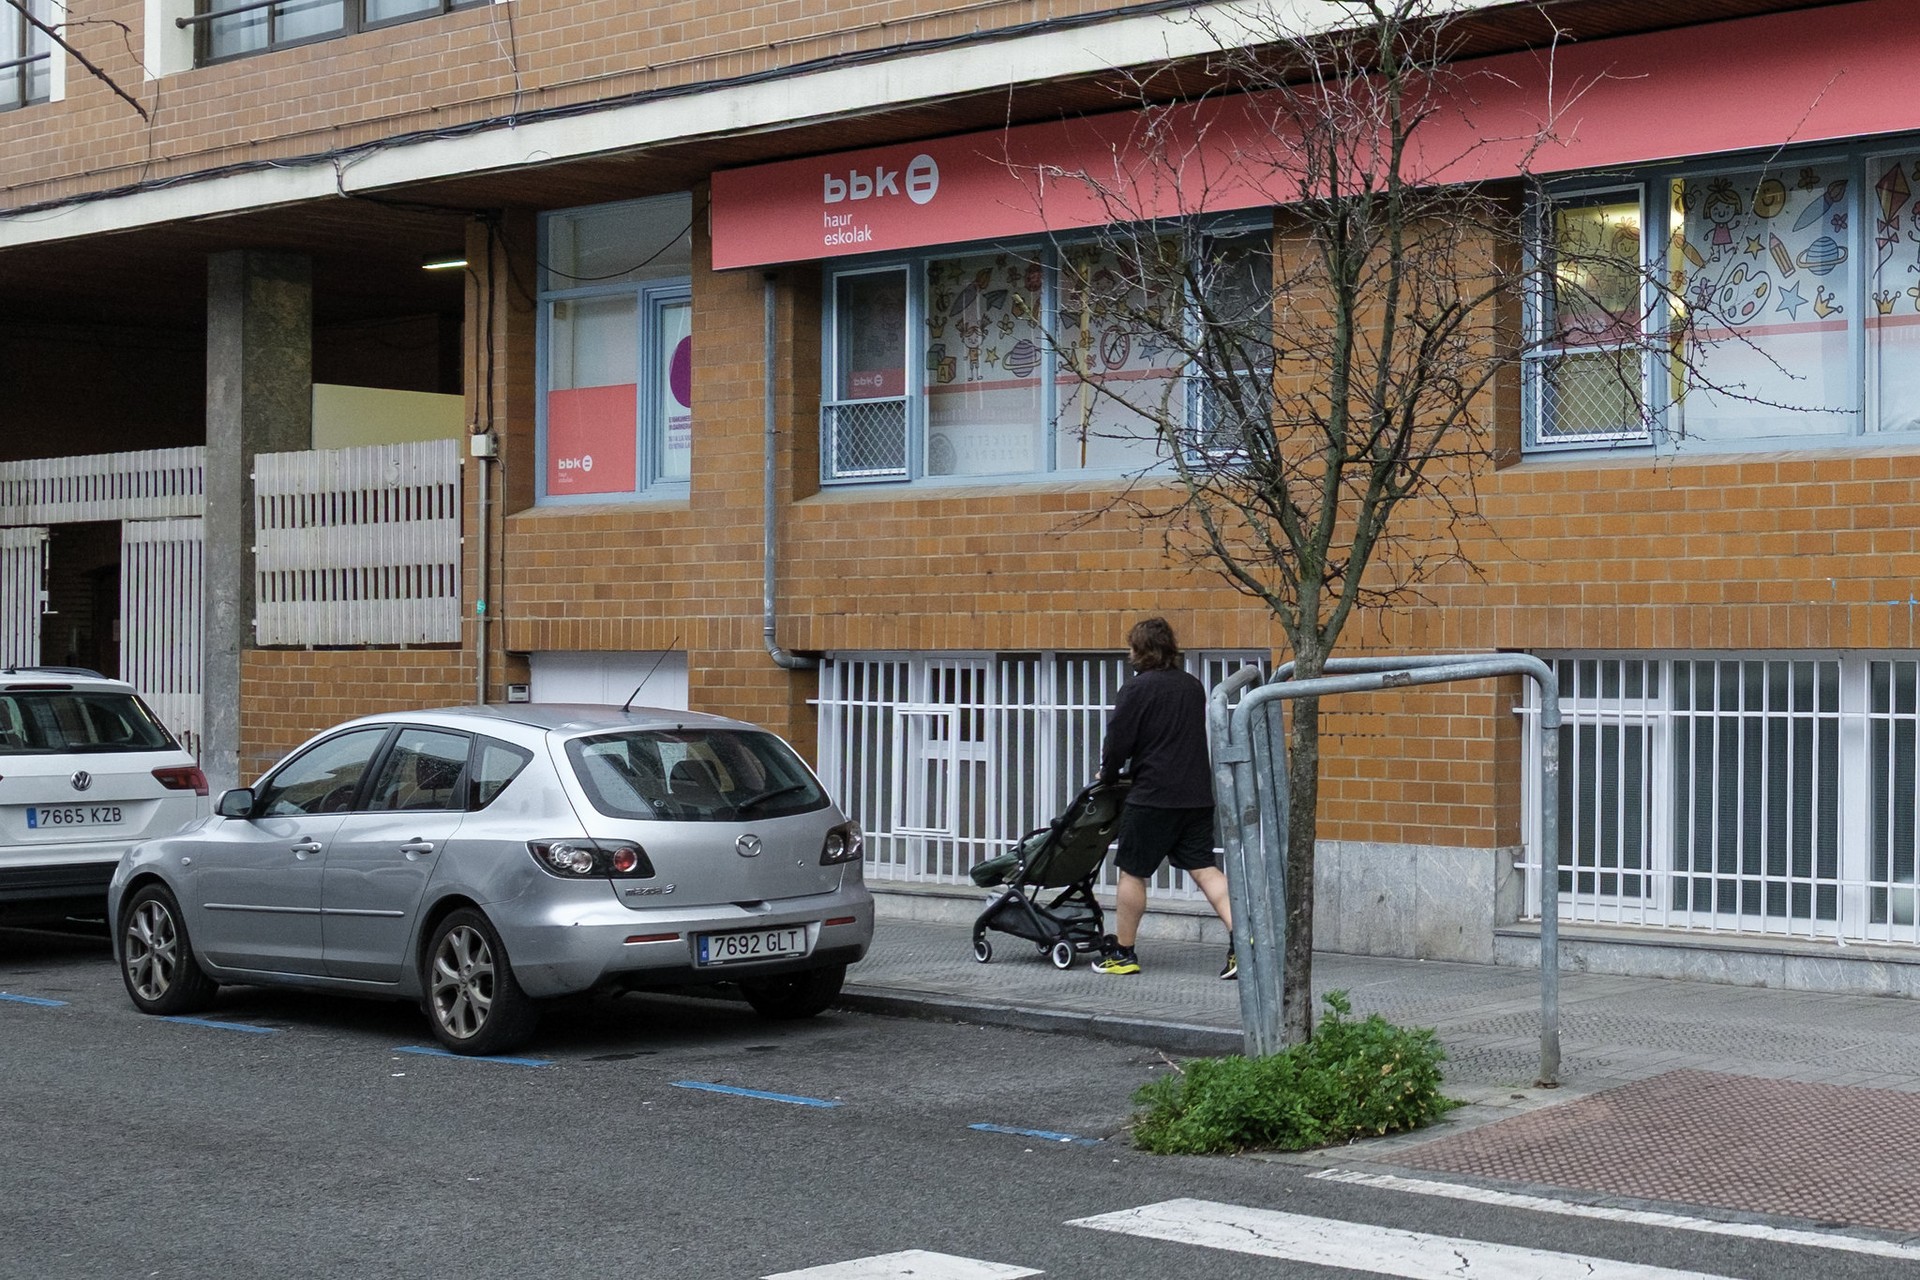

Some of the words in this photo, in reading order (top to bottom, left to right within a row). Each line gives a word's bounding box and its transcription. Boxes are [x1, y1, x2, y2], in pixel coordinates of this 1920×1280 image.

[824, 166, 899, 204] bbk
[824, 211, 853, 228] haur
[824, 224, 873, 246] eskolak
[853, 376, 873, 386] bbk
[558, 458, 581, 470] bbk
[41, 808, 84, 825] 7665
[91, 807, 122, 823] KZB
[714, 934, 760, 957] 7692
[766, 930, 798, 951] GLT
